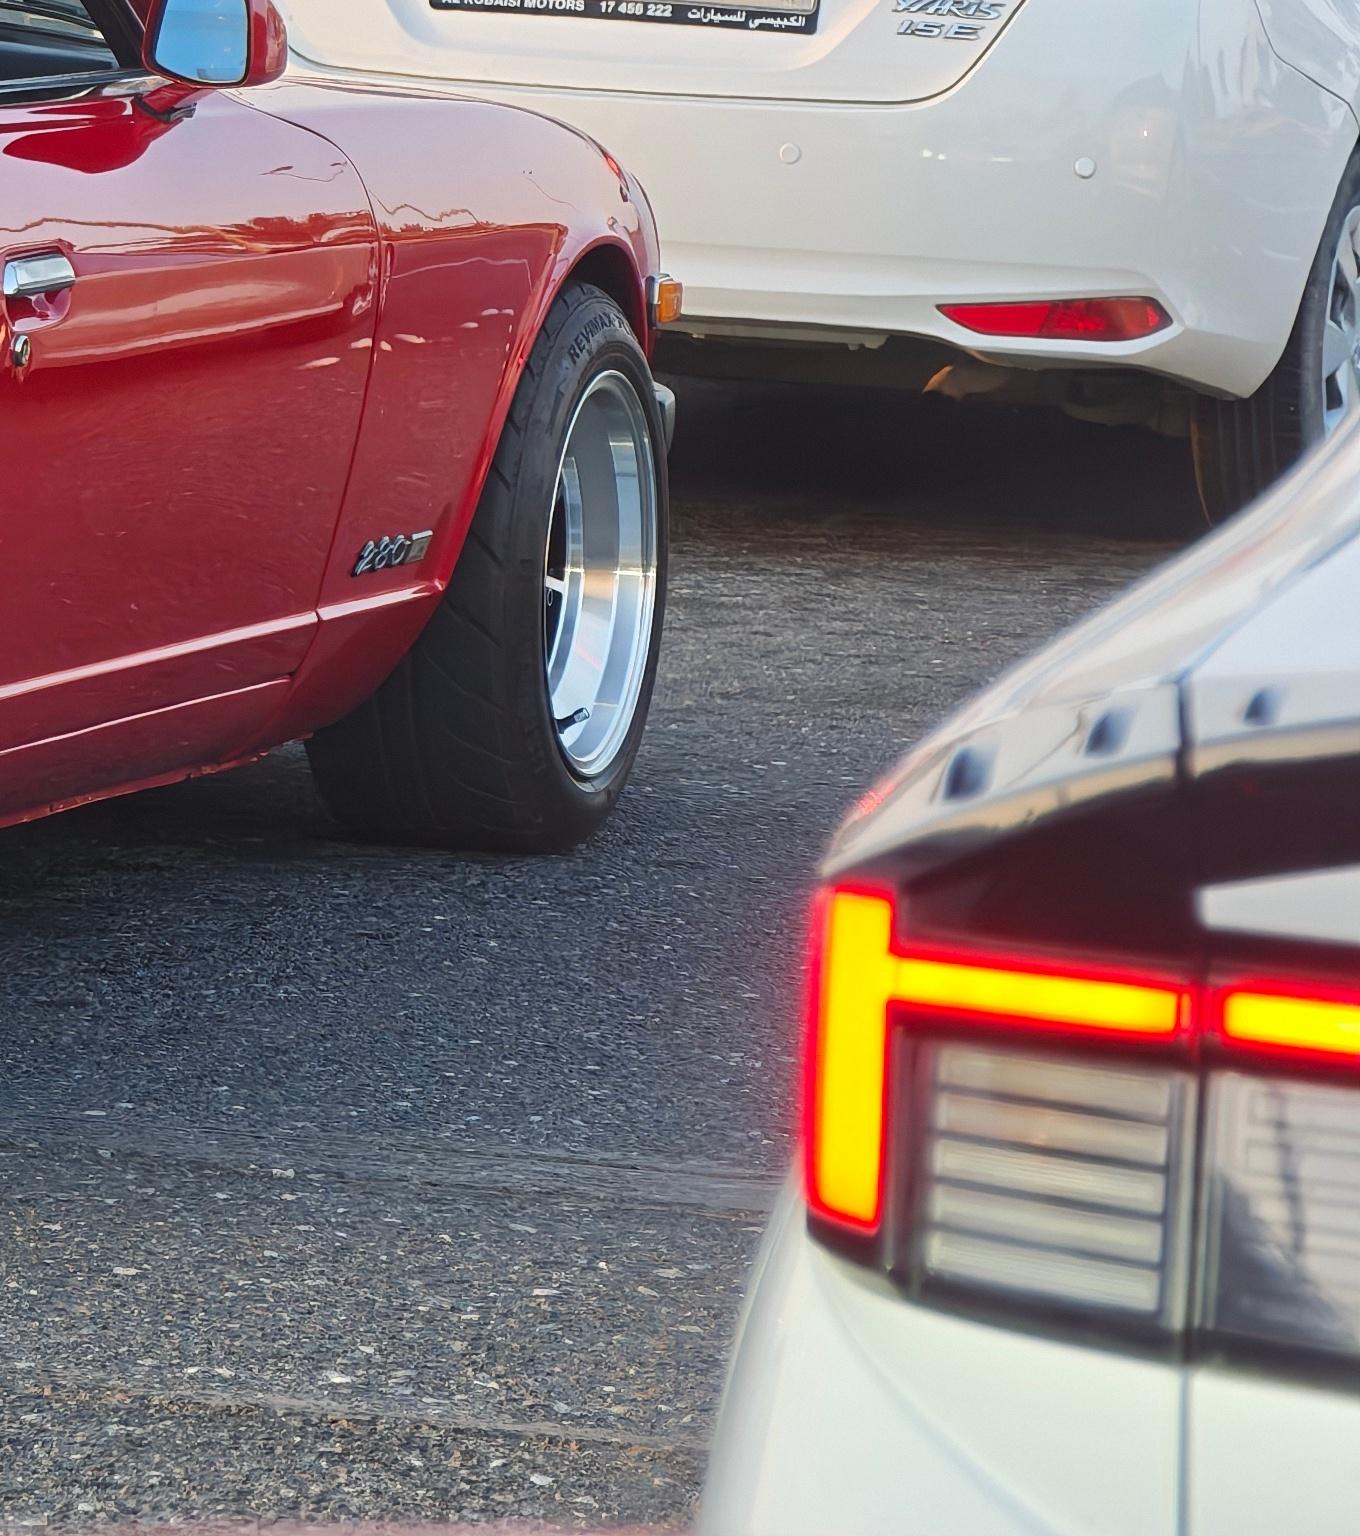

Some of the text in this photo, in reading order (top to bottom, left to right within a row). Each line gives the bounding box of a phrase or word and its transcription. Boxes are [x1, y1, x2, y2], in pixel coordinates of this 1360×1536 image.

[599, 0, 615, 14] 17
[646, 3, 673, 17] 222
[943, 22, 985, 41] E
